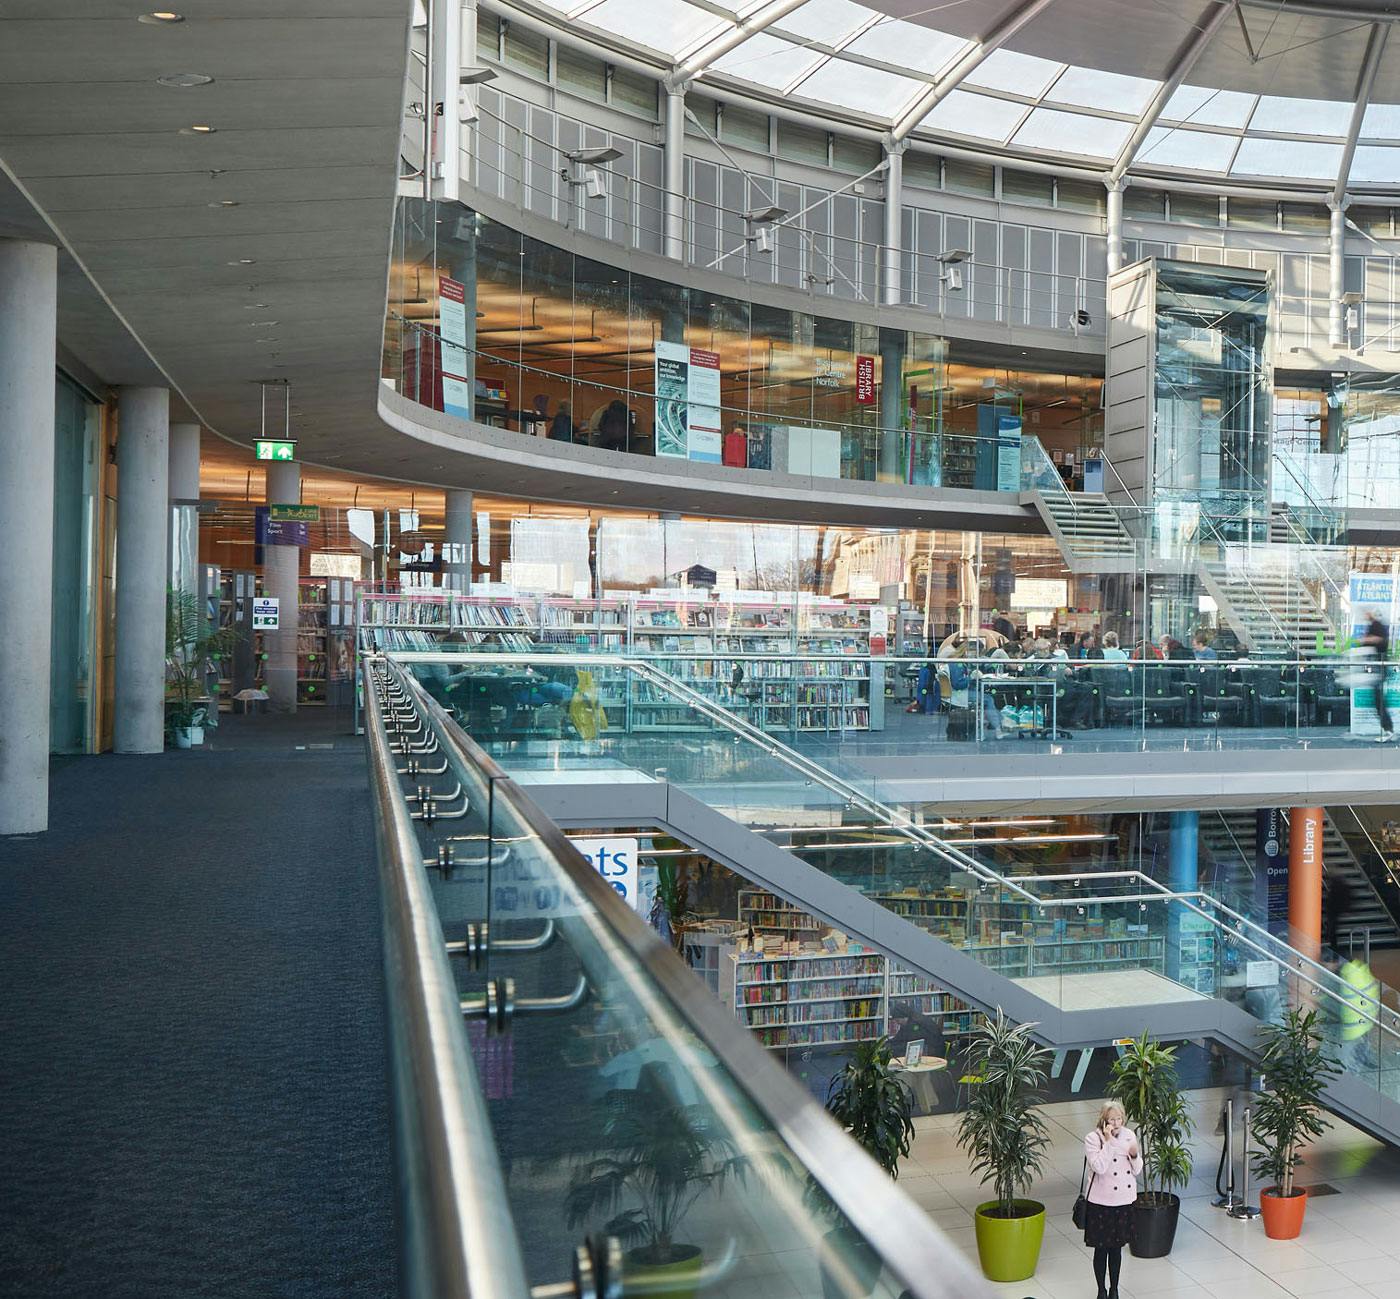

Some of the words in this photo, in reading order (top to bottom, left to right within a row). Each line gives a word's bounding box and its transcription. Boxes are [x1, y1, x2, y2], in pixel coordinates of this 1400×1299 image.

[816, 378, 840, 388] Norfolk
[858, 363, 866, 400] BRITISH
[1303, 817, 1317, 865] Library
[1267, 867, 1289, 877] Open
